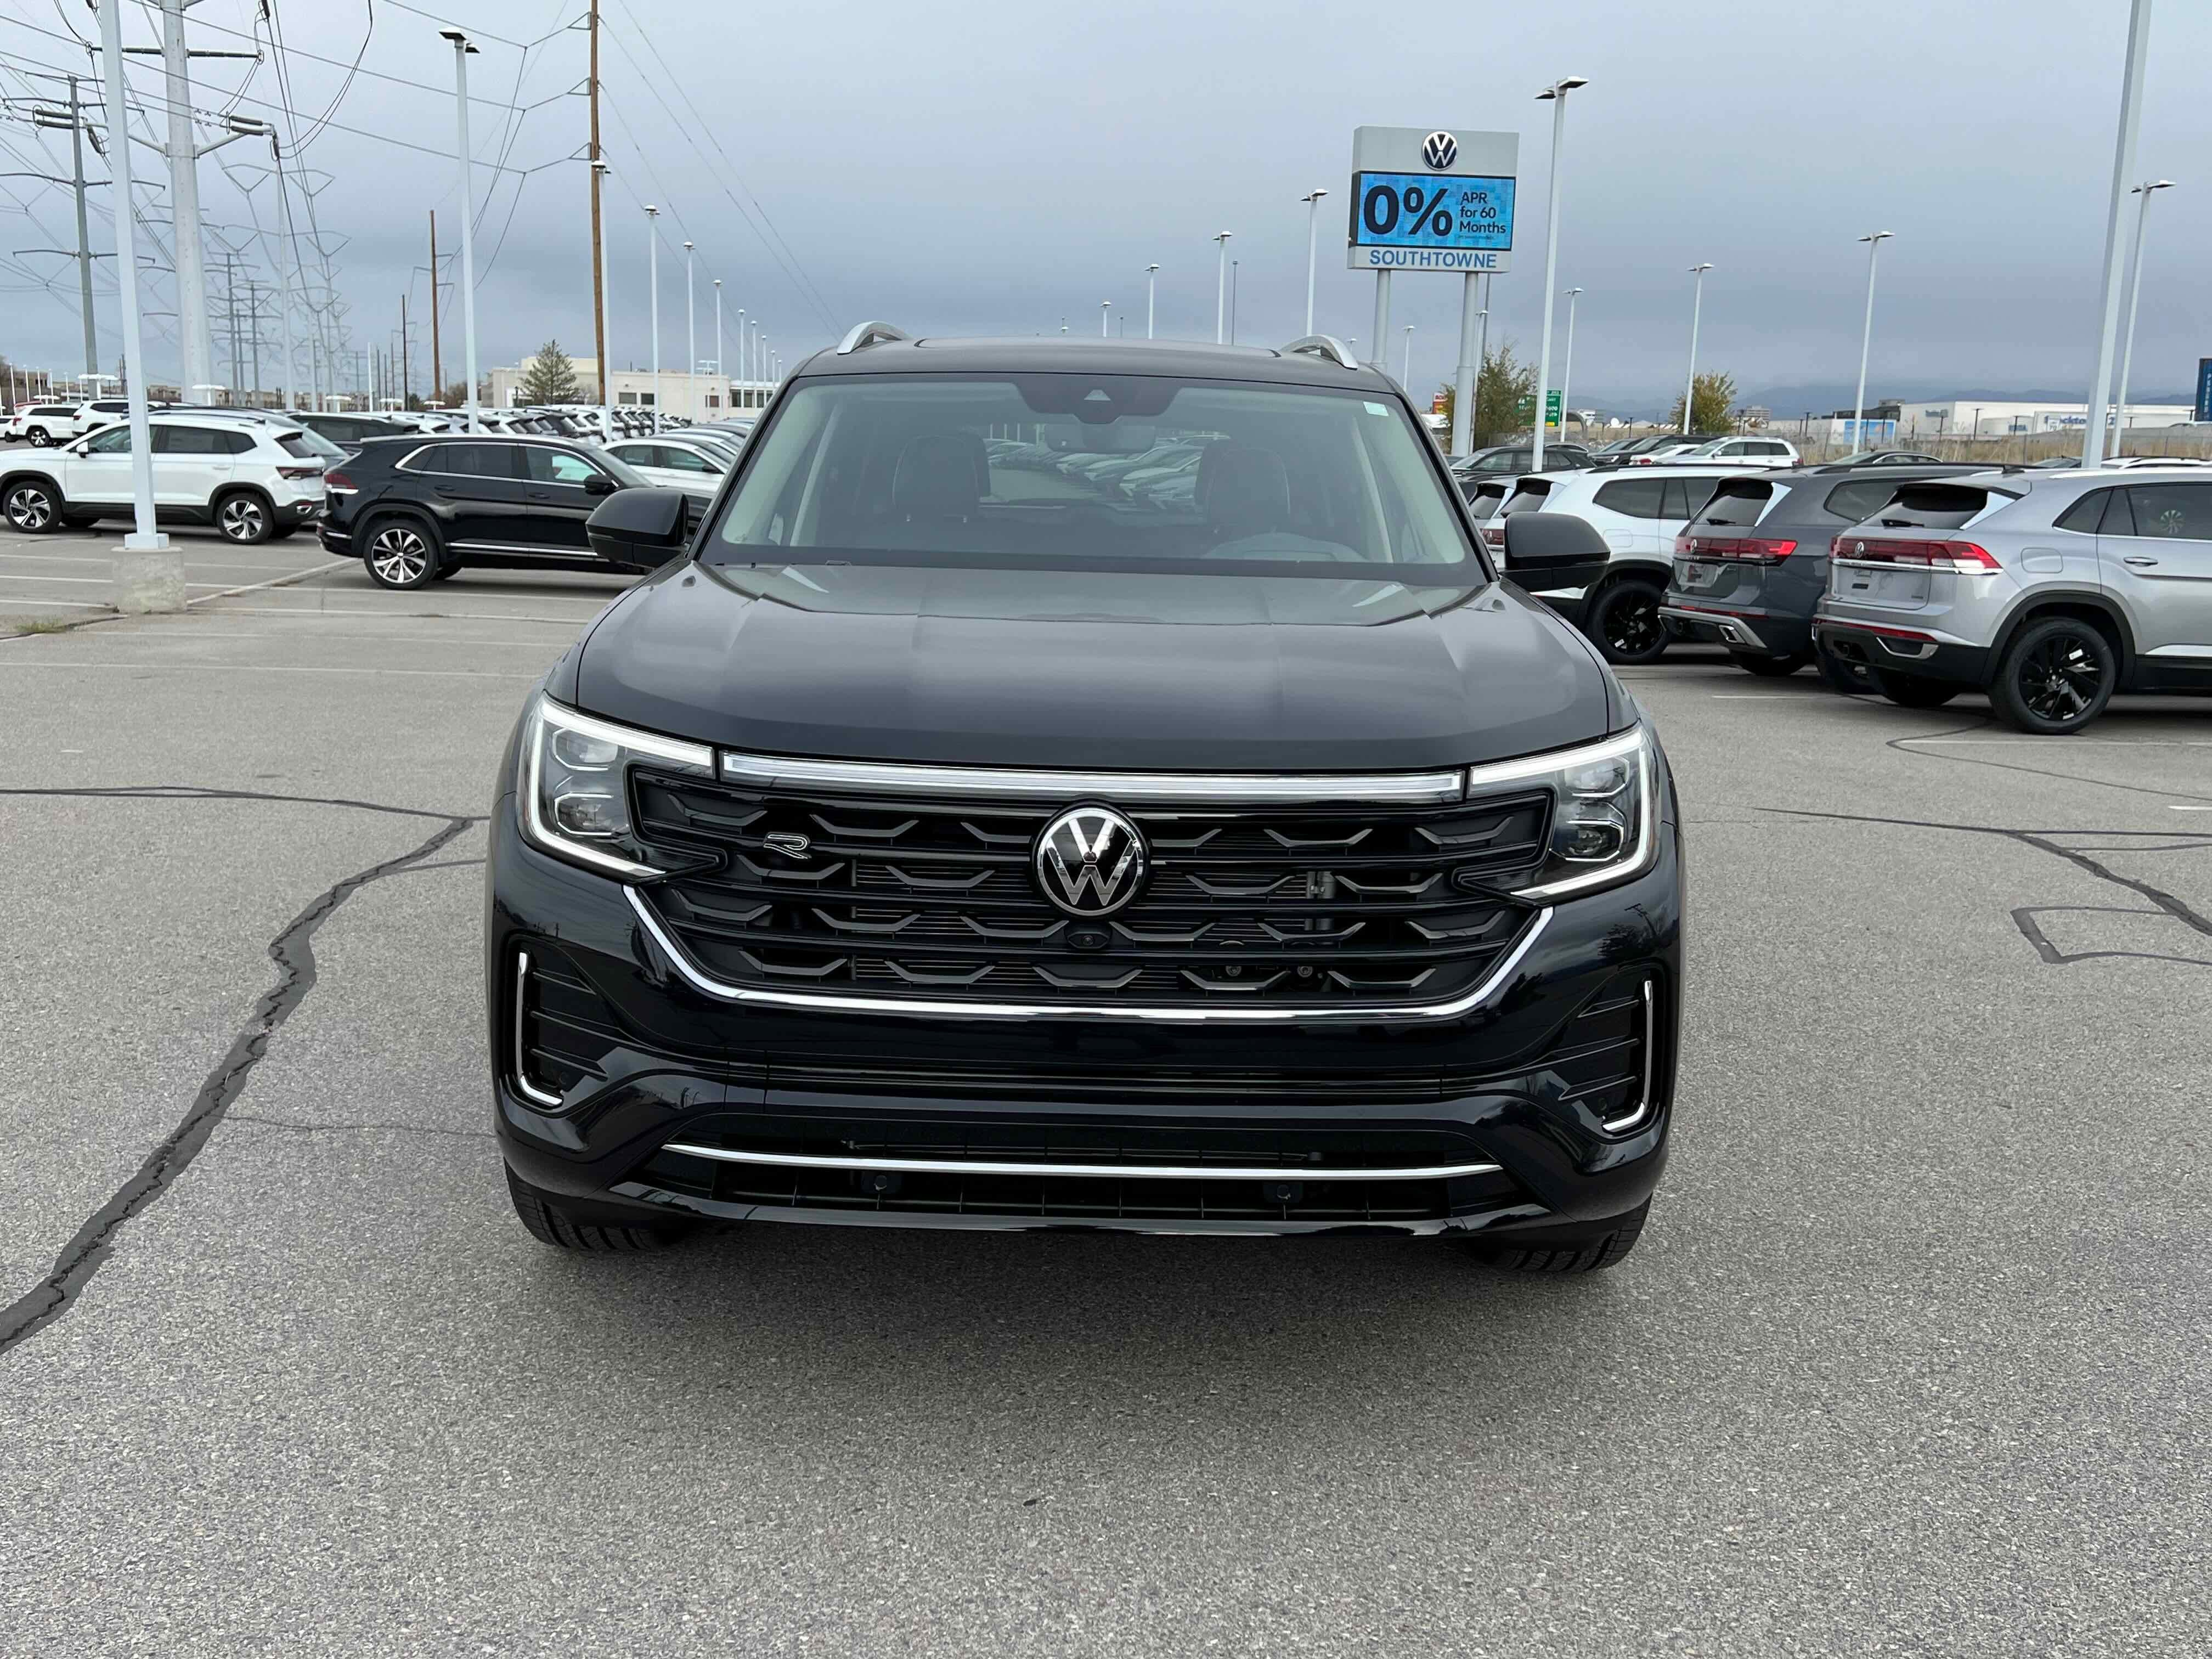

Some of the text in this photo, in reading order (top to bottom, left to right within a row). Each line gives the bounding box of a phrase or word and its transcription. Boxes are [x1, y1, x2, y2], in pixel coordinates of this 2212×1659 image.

[1460, 192, 1487, 205] APR
[1363, 185, 1453, 236] 0%
[1460, 207, 1496, 219] for 60
[1459, 221, 1506, 234] Months
[1369, 250, 1497, 268] SOUTHTOWNE
